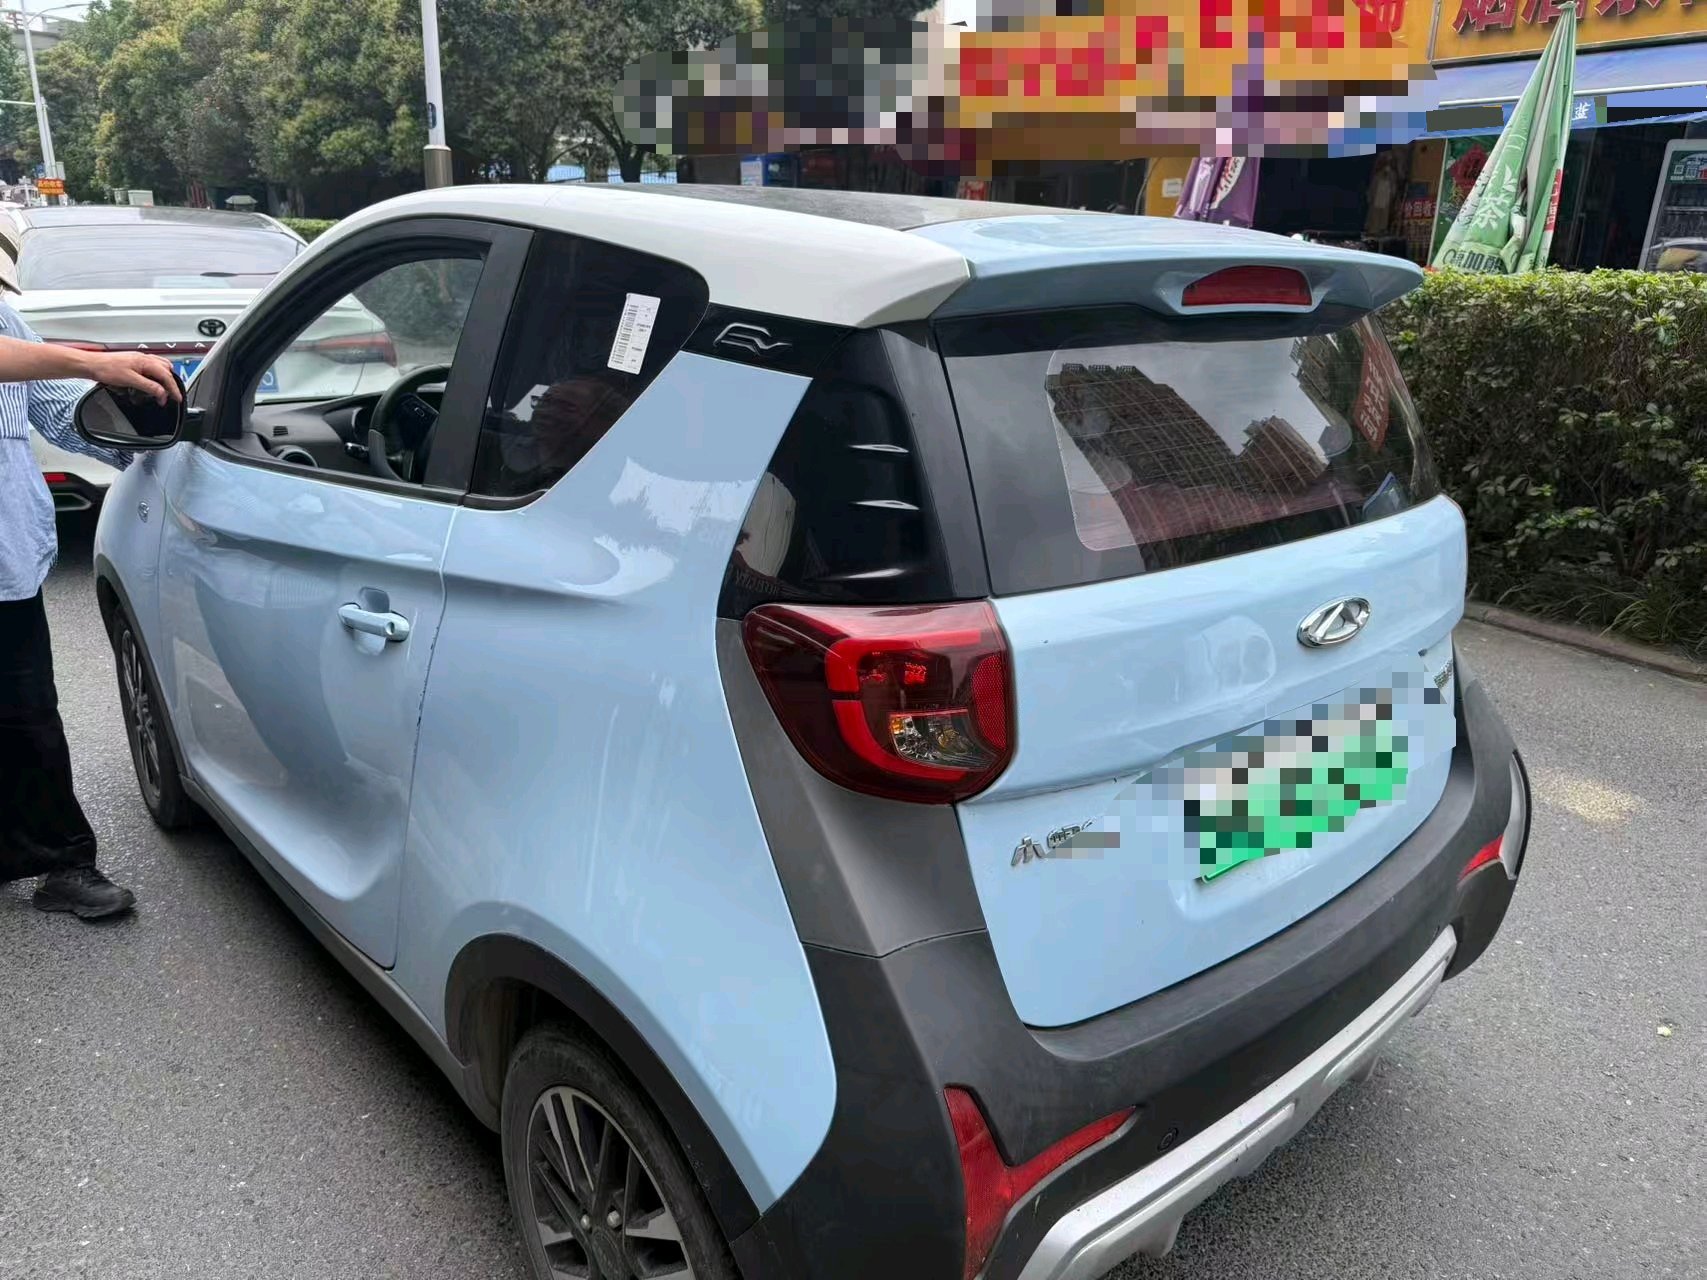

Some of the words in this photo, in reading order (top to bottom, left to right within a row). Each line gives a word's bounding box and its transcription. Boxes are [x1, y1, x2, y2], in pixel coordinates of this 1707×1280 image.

[1404, 200, 1436, 217] 价回收
[1470, 192, 1510, 230] 茶
